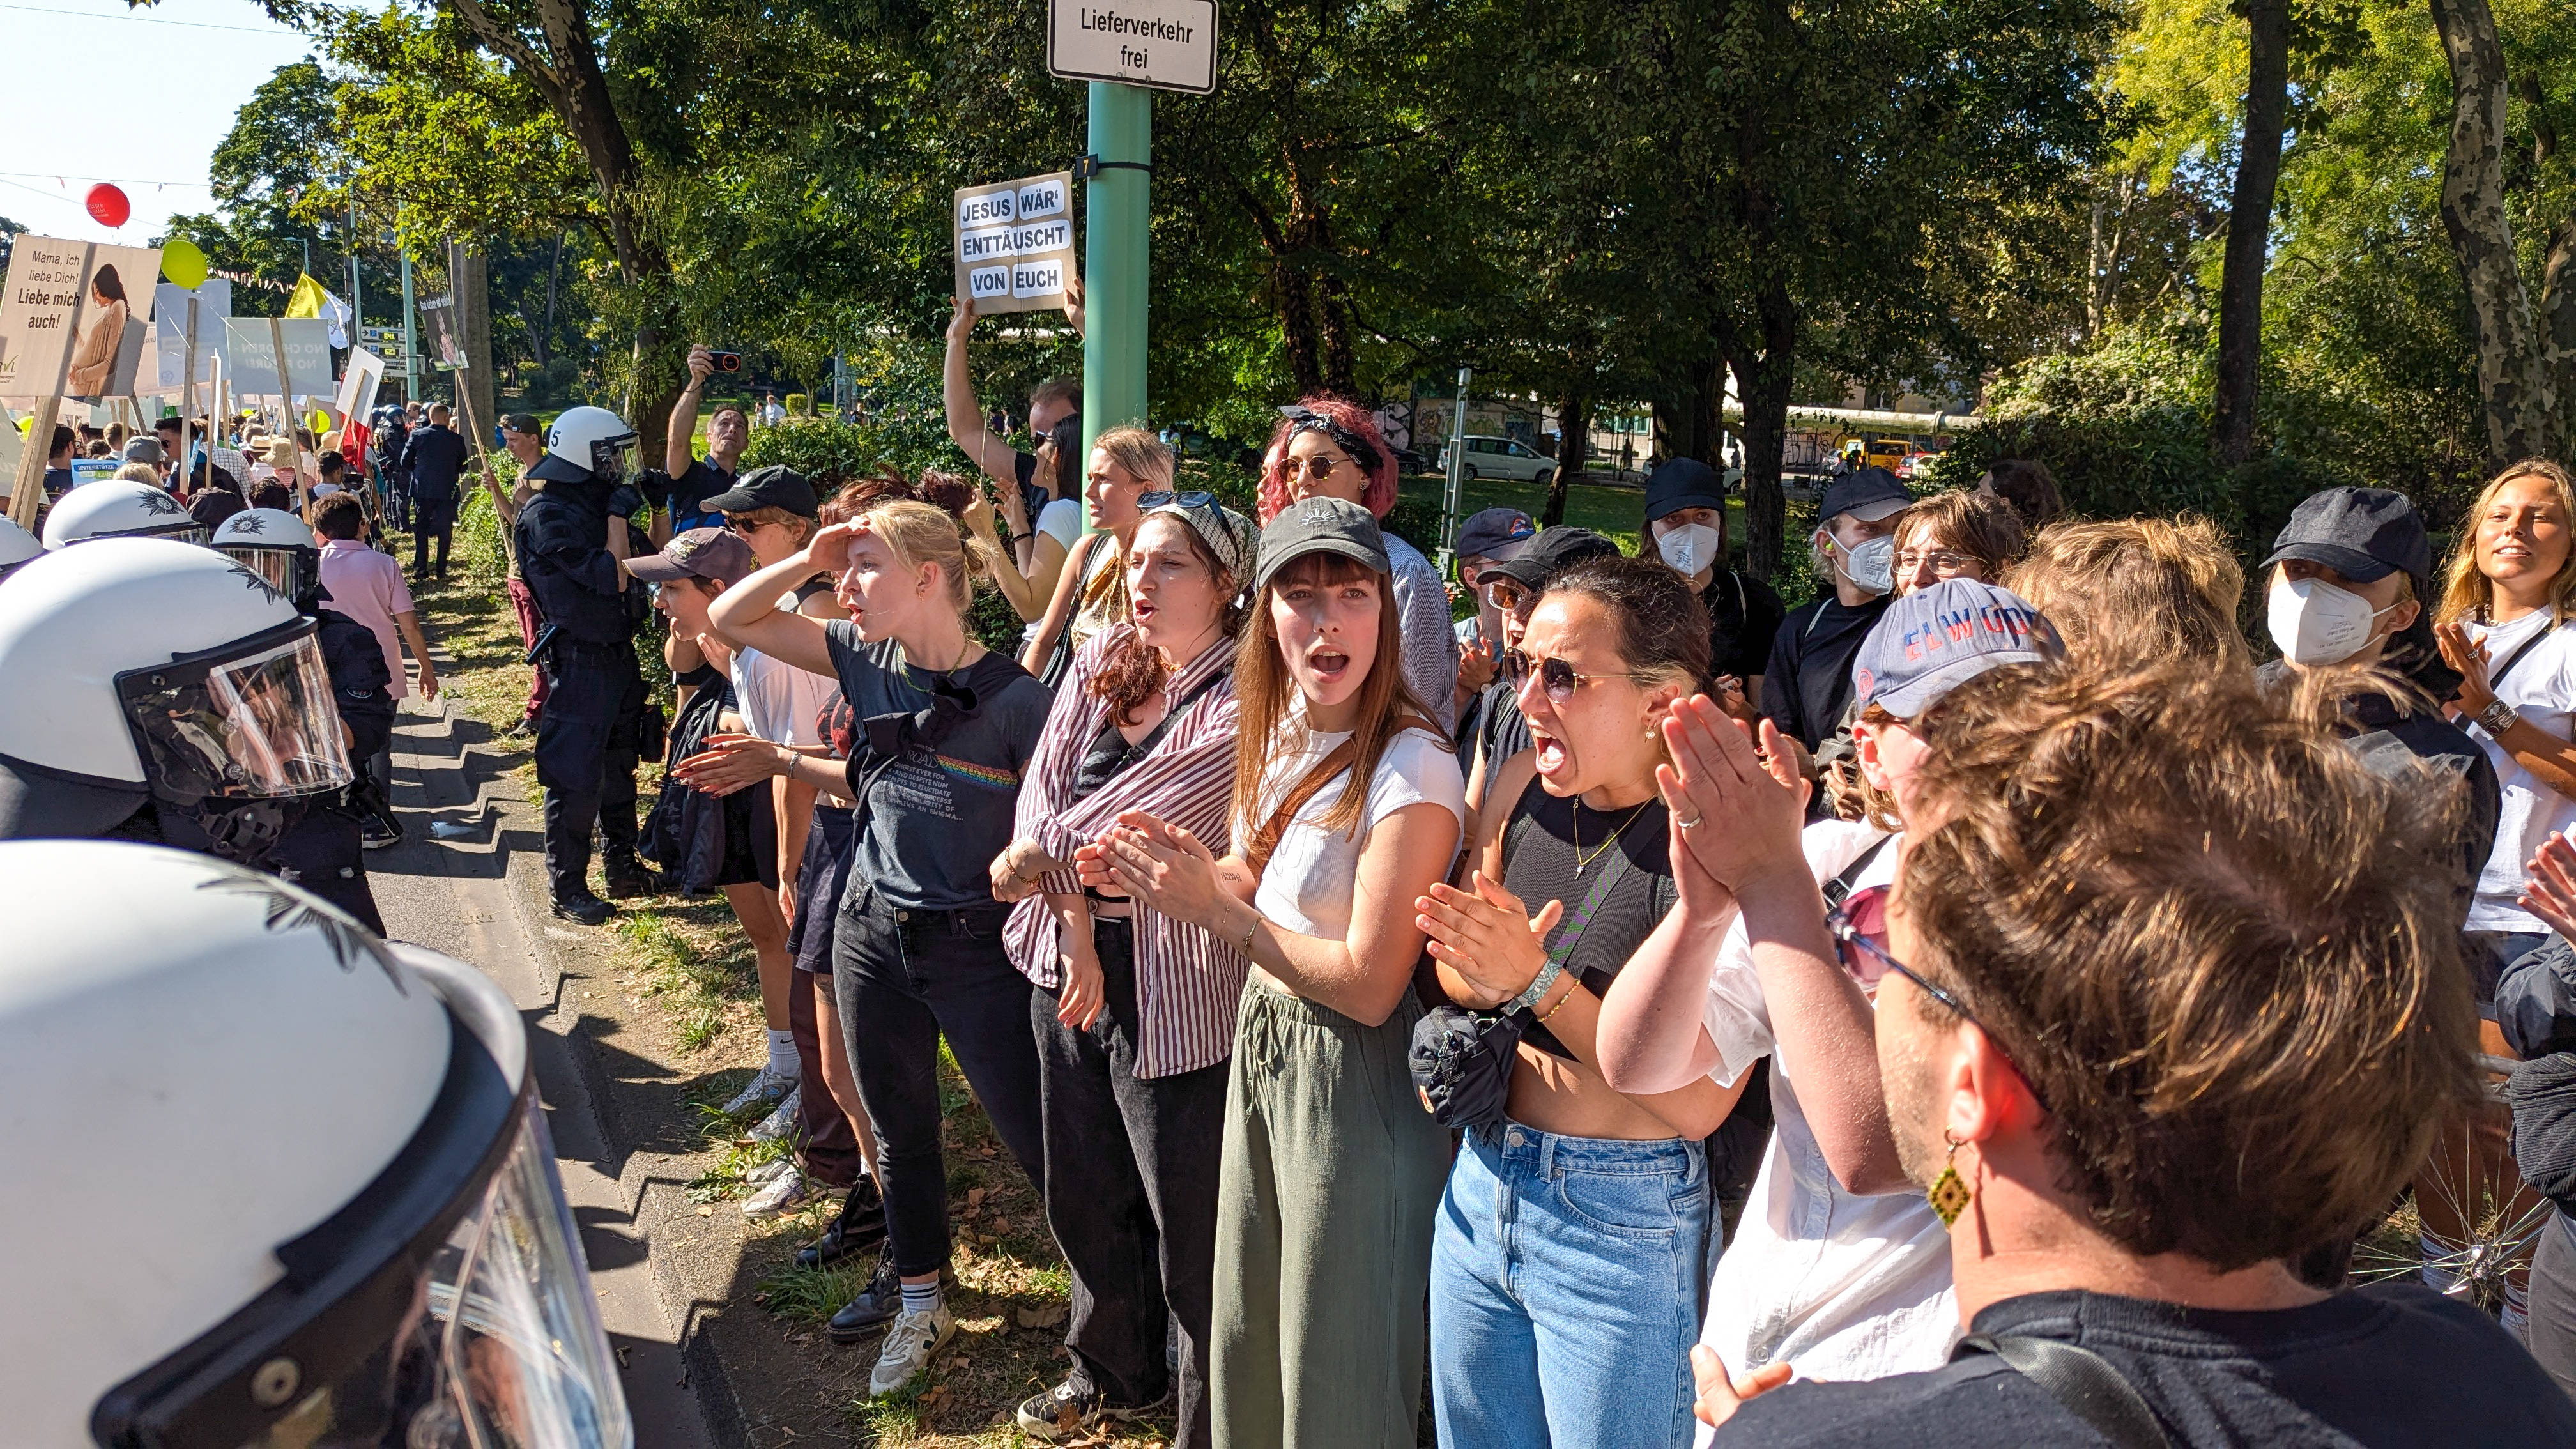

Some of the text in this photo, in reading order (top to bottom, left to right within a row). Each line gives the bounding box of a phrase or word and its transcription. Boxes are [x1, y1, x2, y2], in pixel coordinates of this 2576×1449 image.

[1081, 8, 1193, 43] Lieferverkehr
[1121, 45, 1147, 69] frei
[1083, 159, 1089, 174] 7
[962, 199, 1011, 222] JESUS
[963, 226, 1065, 256] ENTTÄUSCHT
[31, 250, 80, 266] Mama, ich
[29, 269, 79, 284] liebe Dich!
[973, 269, 1058, 291] VON EUCH
[17, 288, 80, 307] Liebe mich
[28, 313, 61, 329] auch!
[551, 429, 561, 447] 5
[907, 750, 939, 769] ROAD
[894, 762, 946, 780] ONGEST EVER FOR
[909, 774, 931, 785] DESPITE
[918, 784, 951, 797] ELUCIDATE
